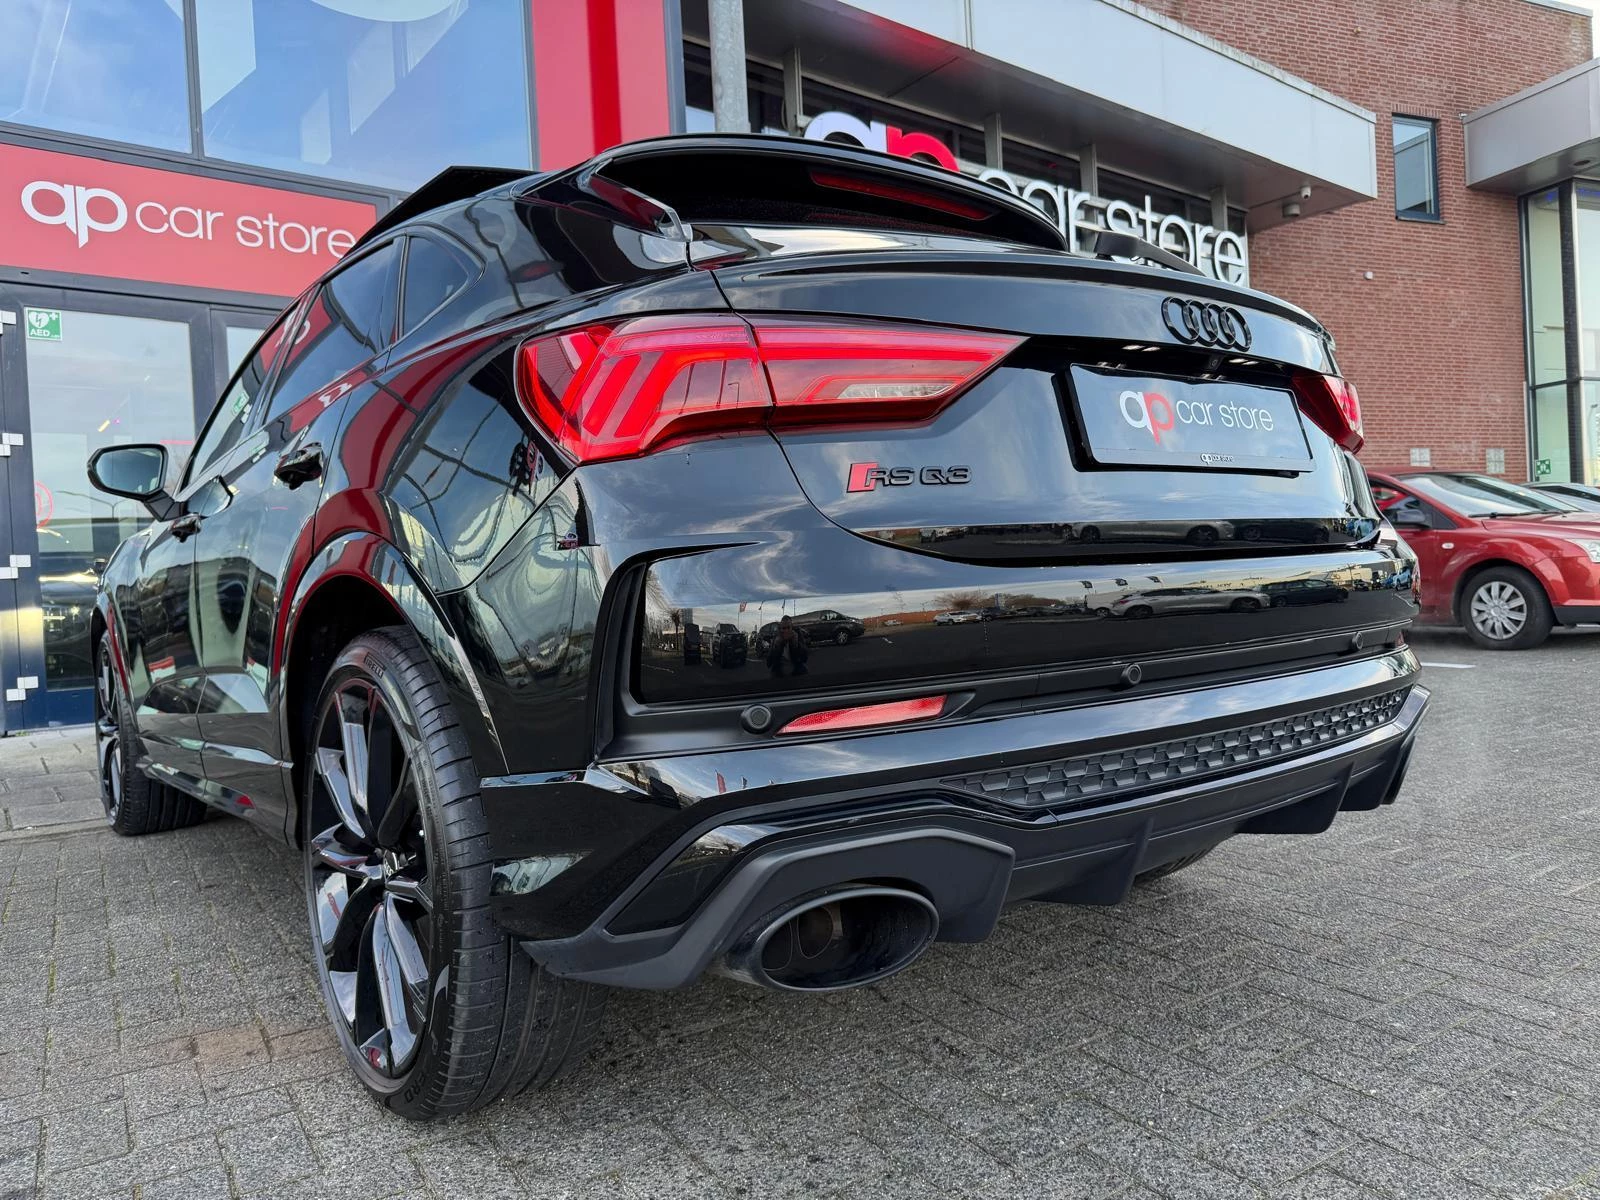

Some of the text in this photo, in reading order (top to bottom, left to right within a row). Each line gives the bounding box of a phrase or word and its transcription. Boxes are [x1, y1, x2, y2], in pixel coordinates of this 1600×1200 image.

[21, 180, 356, 259] ap car store
[978, 169, 1091, 254] ar
[1106, 195, 1247, 287] store
[30, 328, 51, 338] AED
[1119, 390, 1274, 445] ap car store
[863, 465, 972, 487] RS Q3
